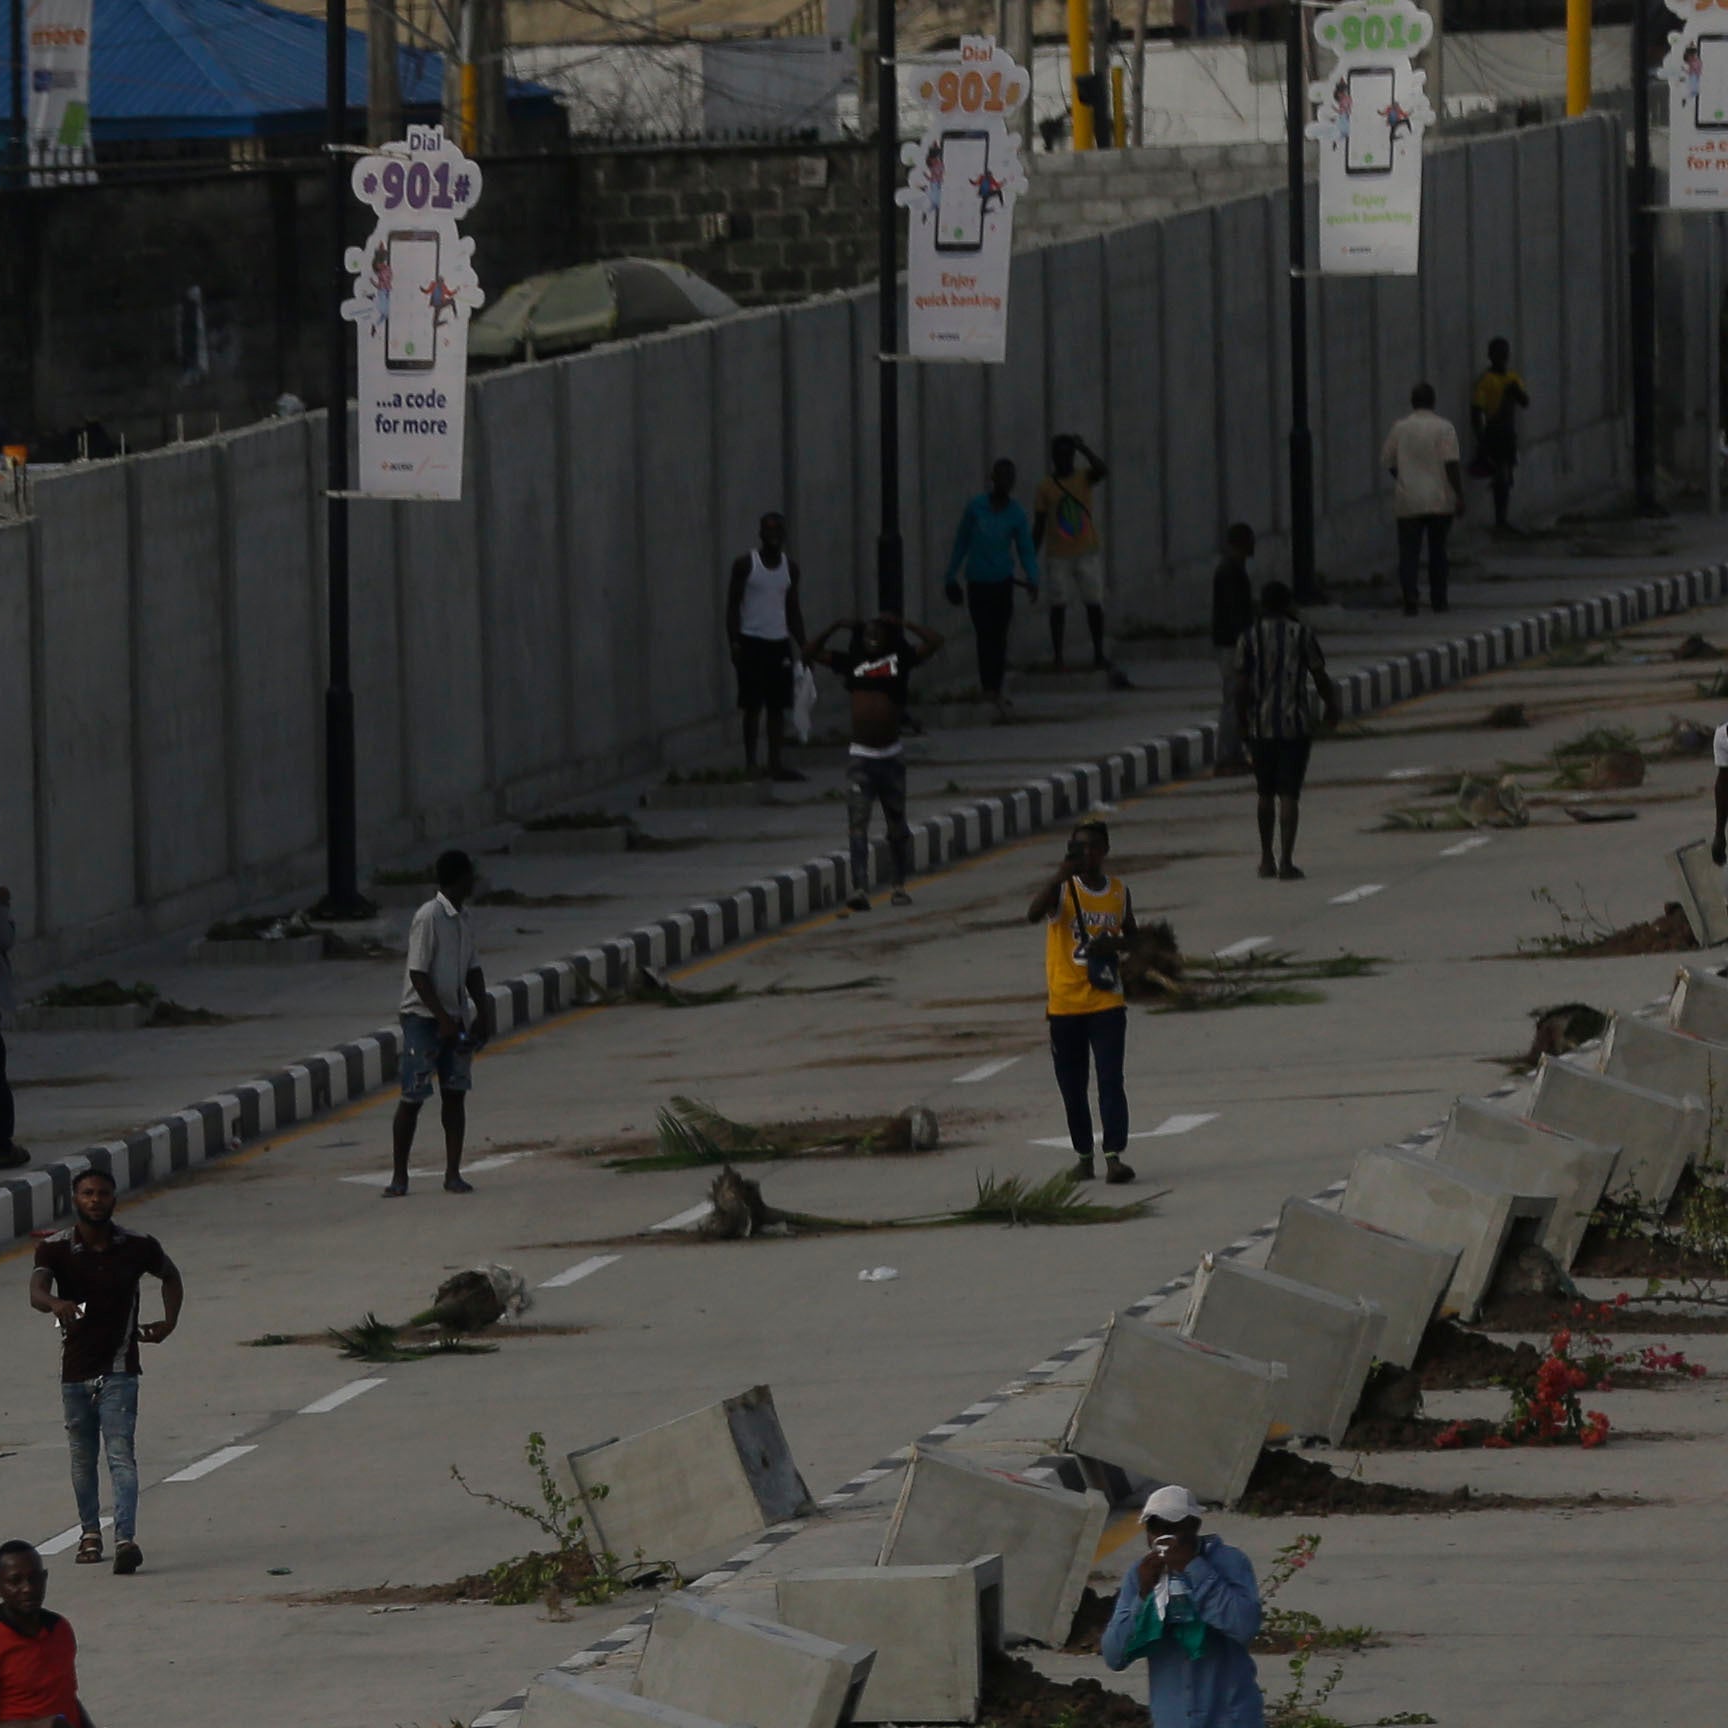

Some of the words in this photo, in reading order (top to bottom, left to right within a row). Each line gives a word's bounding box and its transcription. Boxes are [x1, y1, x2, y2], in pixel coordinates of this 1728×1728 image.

[963, 45, 993, 61] Dial
[410, 133, 441, 151] Dial
[942, 272, 977, 293] Enjoy
[406, 388, 447, 409] code
[375, 413, 400, 434] for
[403, 419, 448, 435] more
